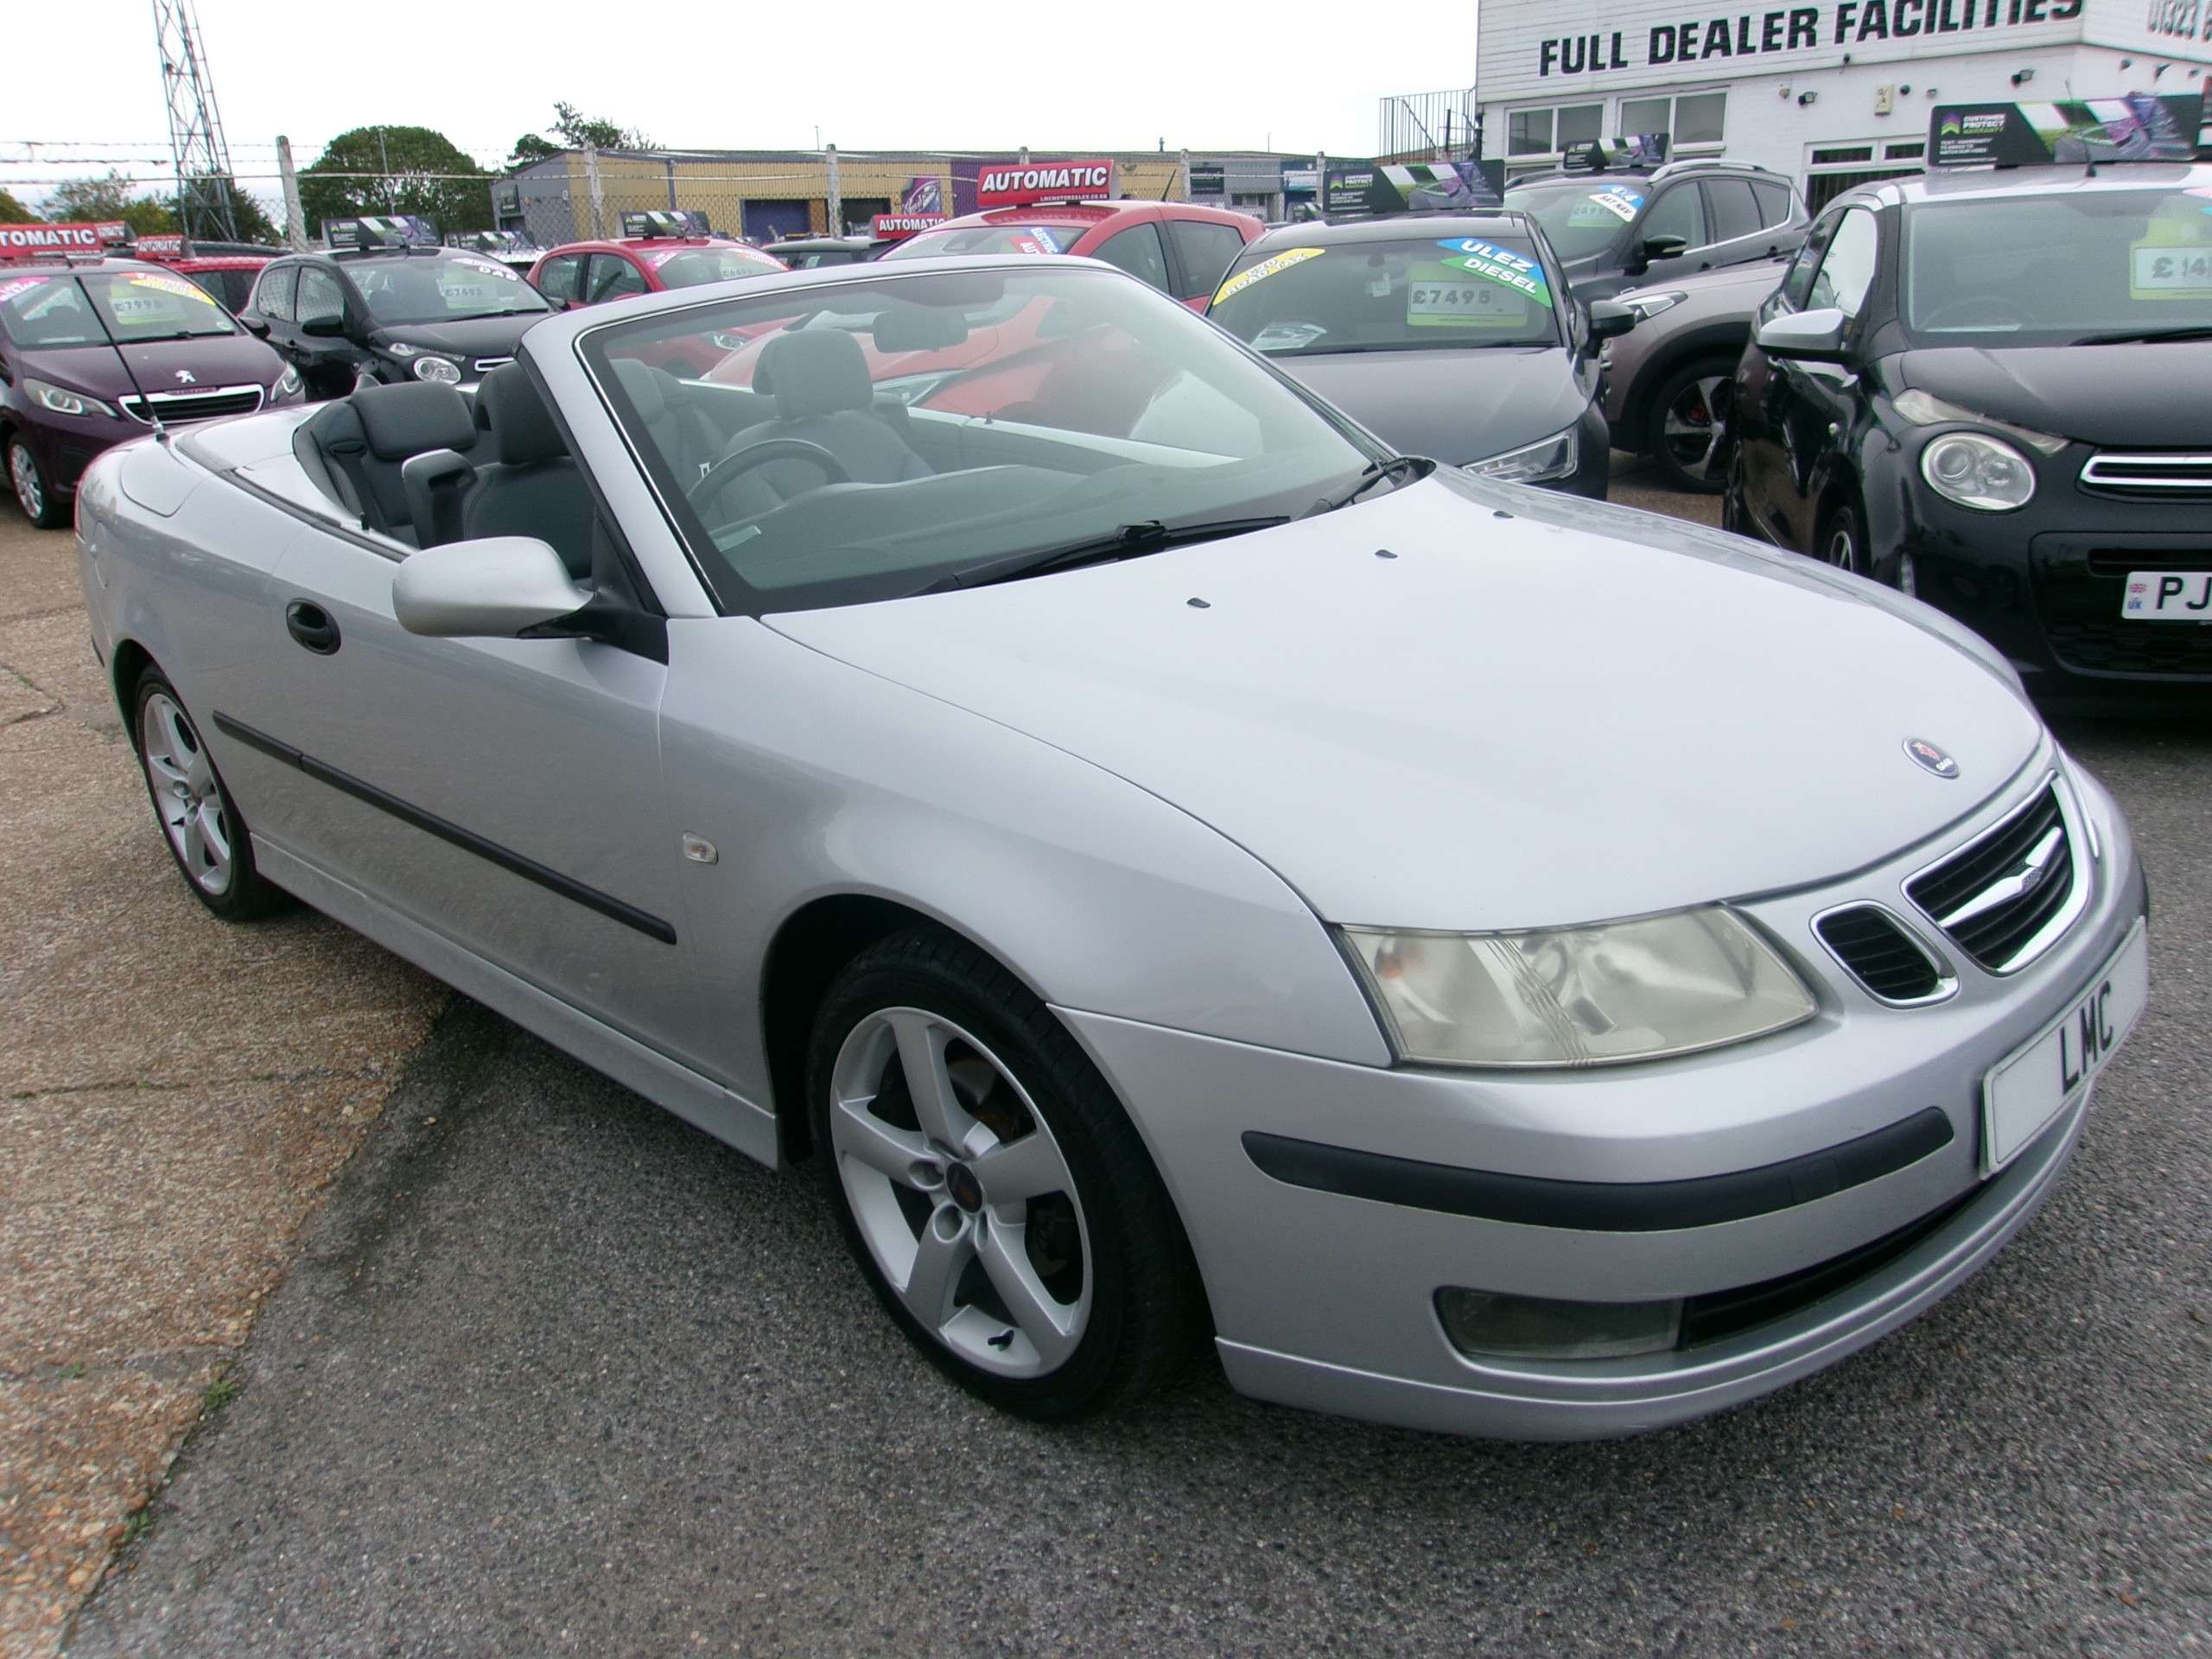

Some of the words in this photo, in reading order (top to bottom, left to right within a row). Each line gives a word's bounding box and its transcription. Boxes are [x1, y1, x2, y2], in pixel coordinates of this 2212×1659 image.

[1540, 32, 1629, 77] FULL
[1648, 8, 1819, 65] DEALER
[981, 167, 1107, 192] AUTOMATIC
[1460, 239, 1534, 273] ULEZ
[1464, 257, 1537, 294] DIESEL
[1412, 289, 1491, 305] £7495
[2059, 980, 2113, 1096] LMC
